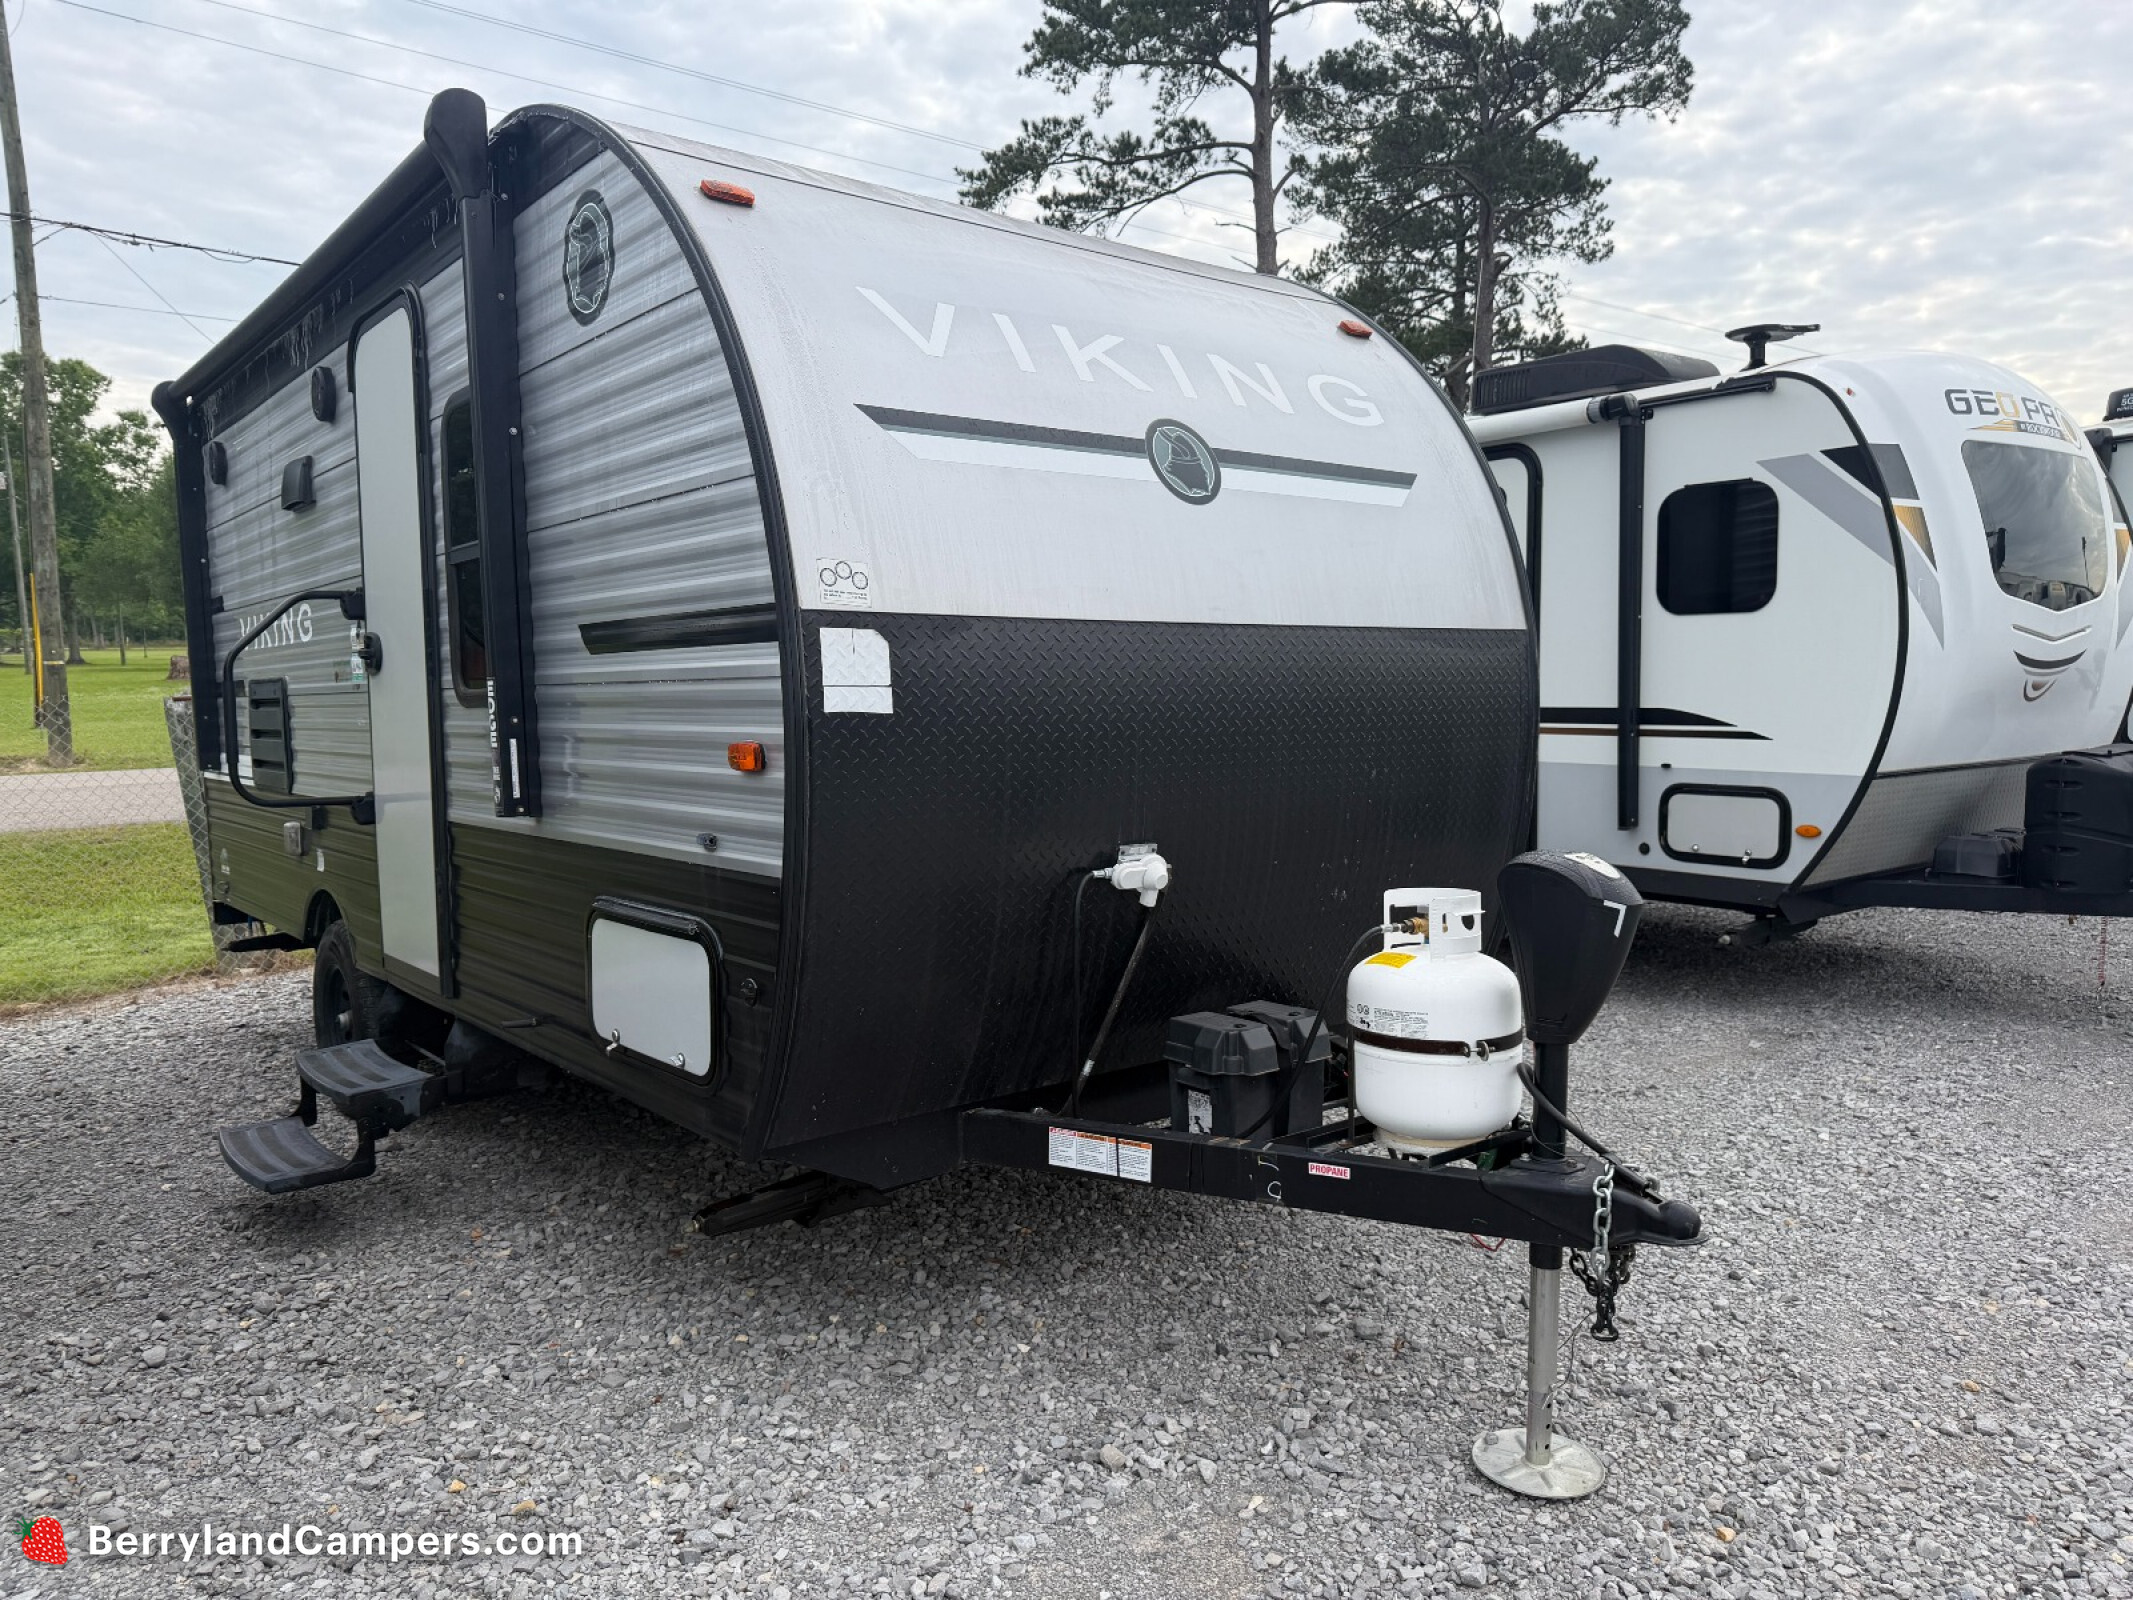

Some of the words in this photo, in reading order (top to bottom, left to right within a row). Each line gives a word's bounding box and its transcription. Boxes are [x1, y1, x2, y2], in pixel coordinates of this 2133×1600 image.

[855, 286, 1385, 427] VIKING
[1944, 388, 2020, 418] GEO
[1309, 1163, 1349, 1178] PROPANE
